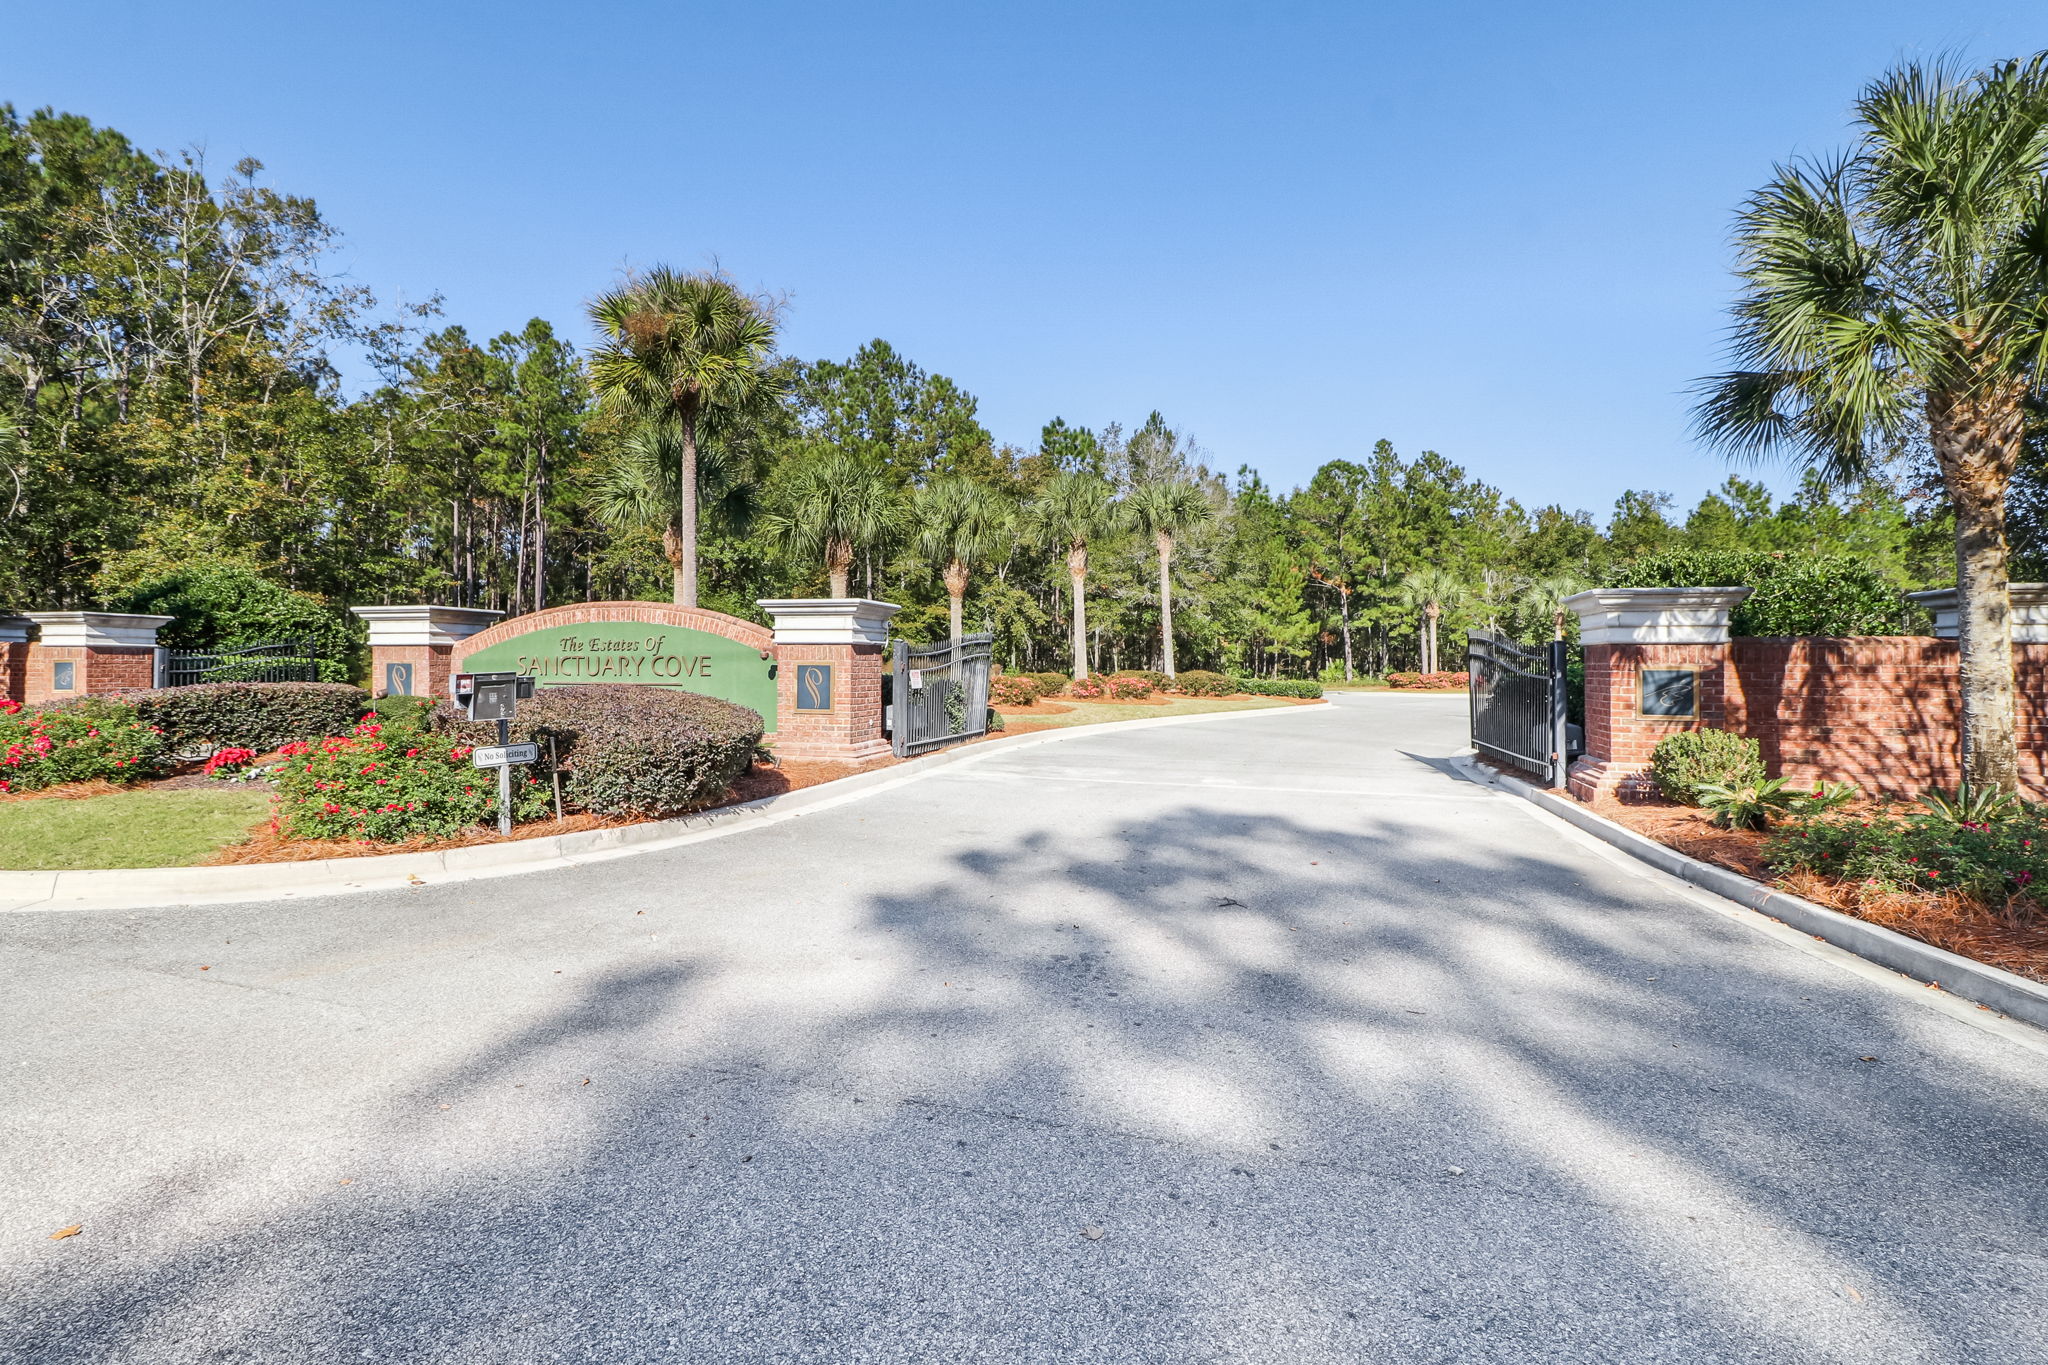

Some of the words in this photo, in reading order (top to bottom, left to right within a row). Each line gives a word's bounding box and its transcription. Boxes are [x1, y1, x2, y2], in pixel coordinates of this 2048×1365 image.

[560, 636, 584, 652] The
[589, 637, 640, 652] Estates
[644, 635, 666, 657] Of
[515, 655, 646, 677] SANCTUARY
[650, 655, 712, 677] COVE
[484, 752, 494, 761] No
[495, 749, 528, 760] Soliciting
